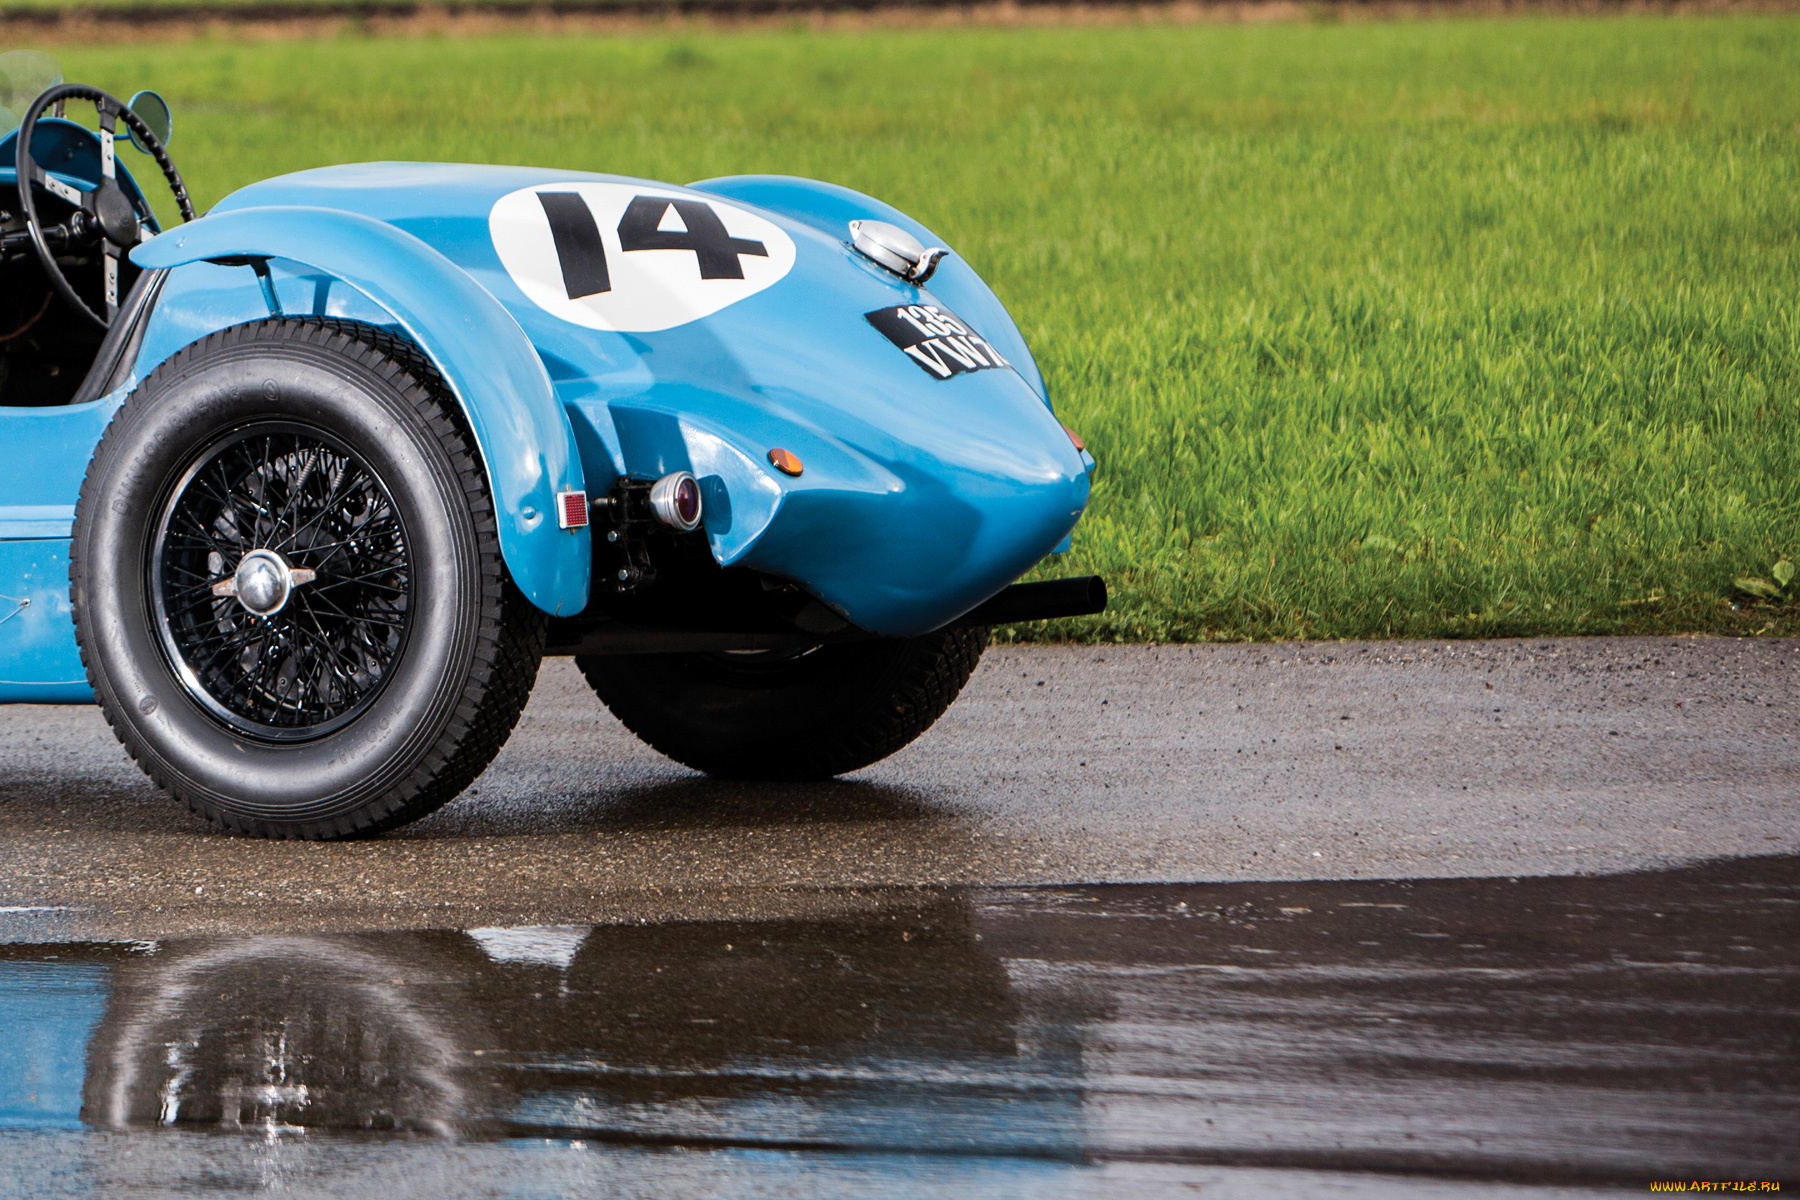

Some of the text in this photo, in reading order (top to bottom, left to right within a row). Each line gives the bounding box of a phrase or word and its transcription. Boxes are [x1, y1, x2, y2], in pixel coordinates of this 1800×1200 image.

[535, 191, 769, 299] 14
[897, 305, 967, 338] 135
[112, 430, 168, 515] DUNLOP
[169, 384, 241, 428] RACING
